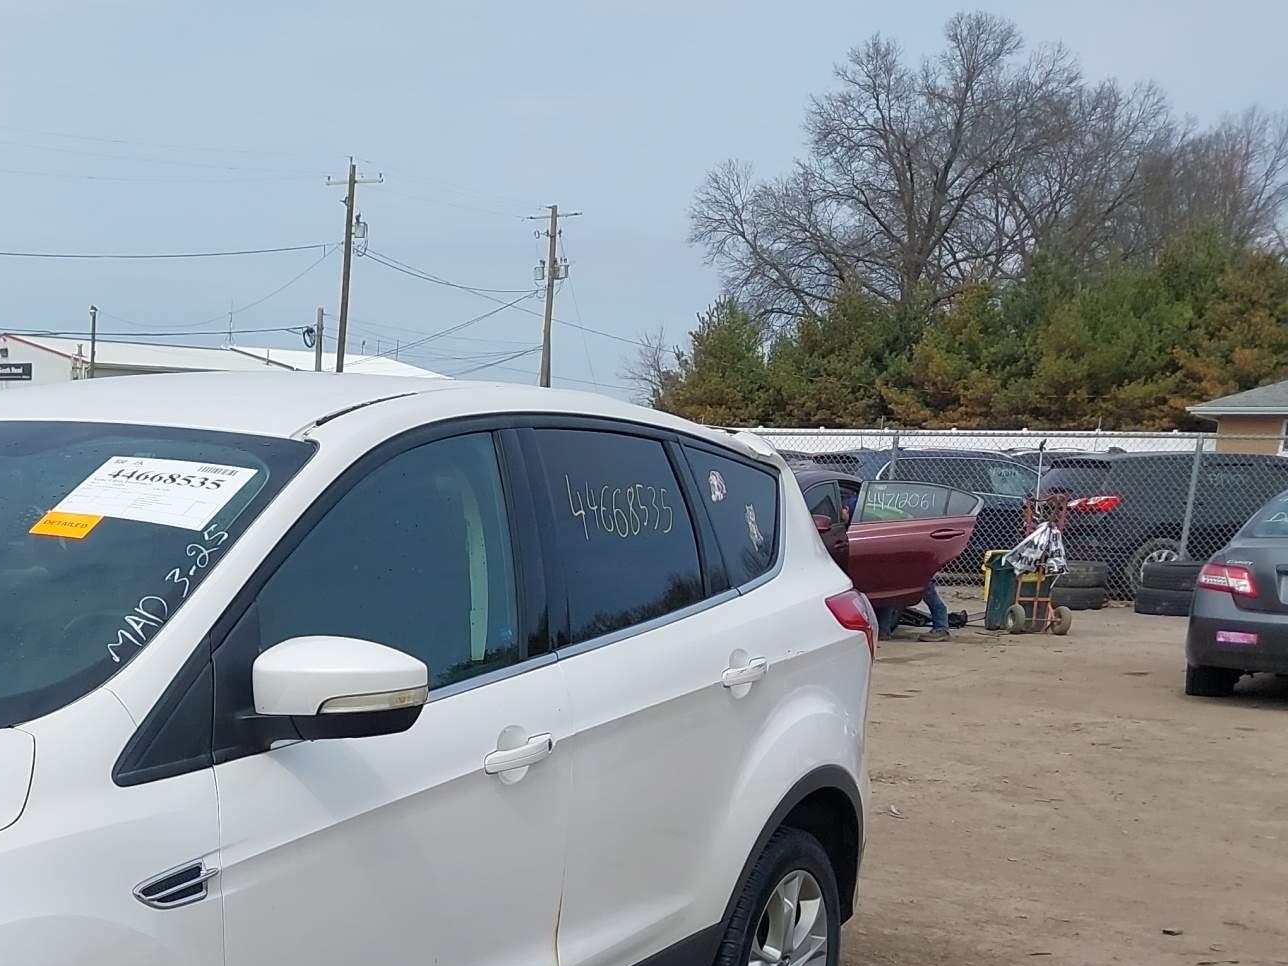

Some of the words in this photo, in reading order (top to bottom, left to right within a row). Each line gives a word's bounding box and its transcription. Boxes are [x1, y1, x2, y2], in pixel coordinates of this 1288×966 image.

[108, 468, 227, 490] 44668535
[43, 519, 89, 529] DETAILED
[107, 595, 168, 663] MAD
[165, 523, 229, 598] 3-25
